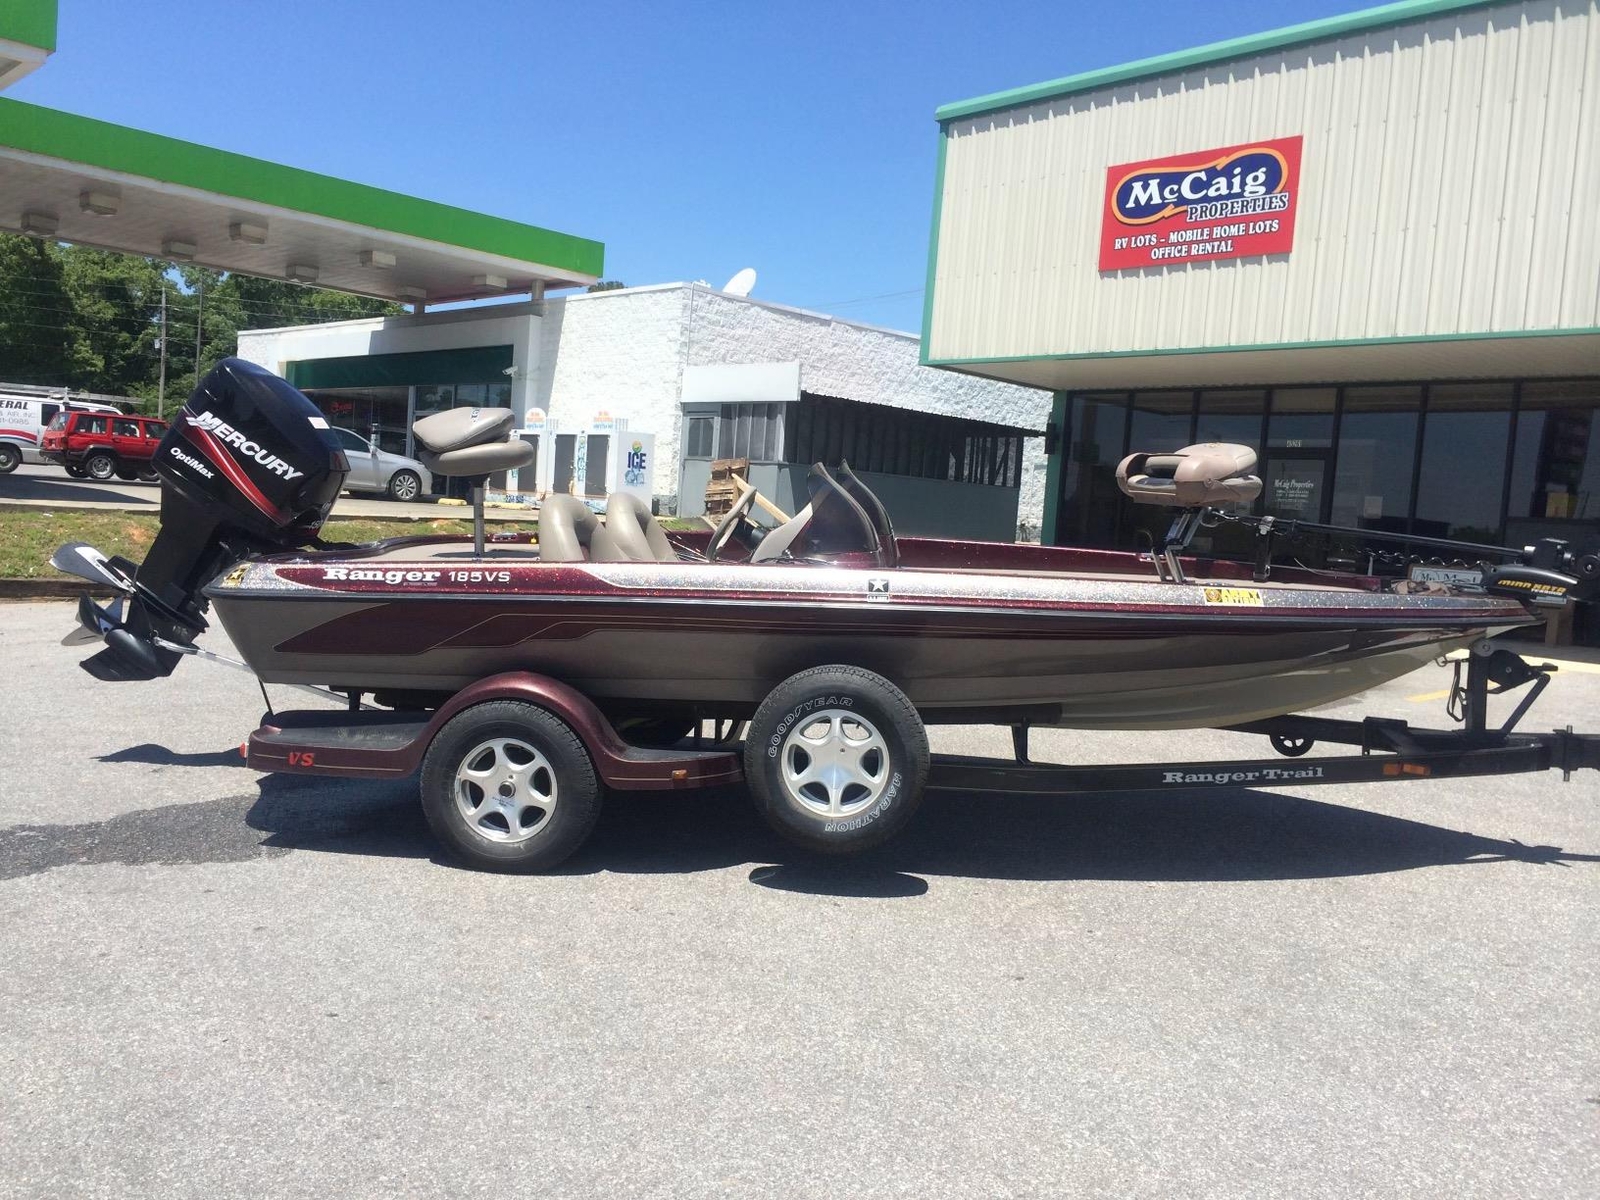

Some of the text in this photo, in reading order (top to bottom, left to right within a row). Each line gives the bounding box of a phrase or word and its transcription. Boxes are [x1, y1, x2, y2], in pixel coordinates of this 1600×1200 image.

[1126, 166, 1267, 208] McCaig
[1187, 193, 1289, 221] PROPERTIES
[1114, 237, 1129, 250] RV
[1131, 233, 1157, 249] LOTS
[1169, 228, 1210, 244] MOBILE
[1213, 224, 1246, 238] HOME
[1249, 219, 1280, 234] LOTS
[1151, 240, 1234, 260] OFFICE RENTAL
[186, 411, 304, 480] MERCURY
[627, 451, 647, 469] ICE
[170, 447, 215, 479] OptiMax
[322, 567, 441, 584] Ranger
[768, 696, 854, 758] GOODYEAR
[287, 752, 316, 767] VS
[1162, 766, 1325, 784] Ranger Trail
[824, 772, 903, 832] MARATHON
